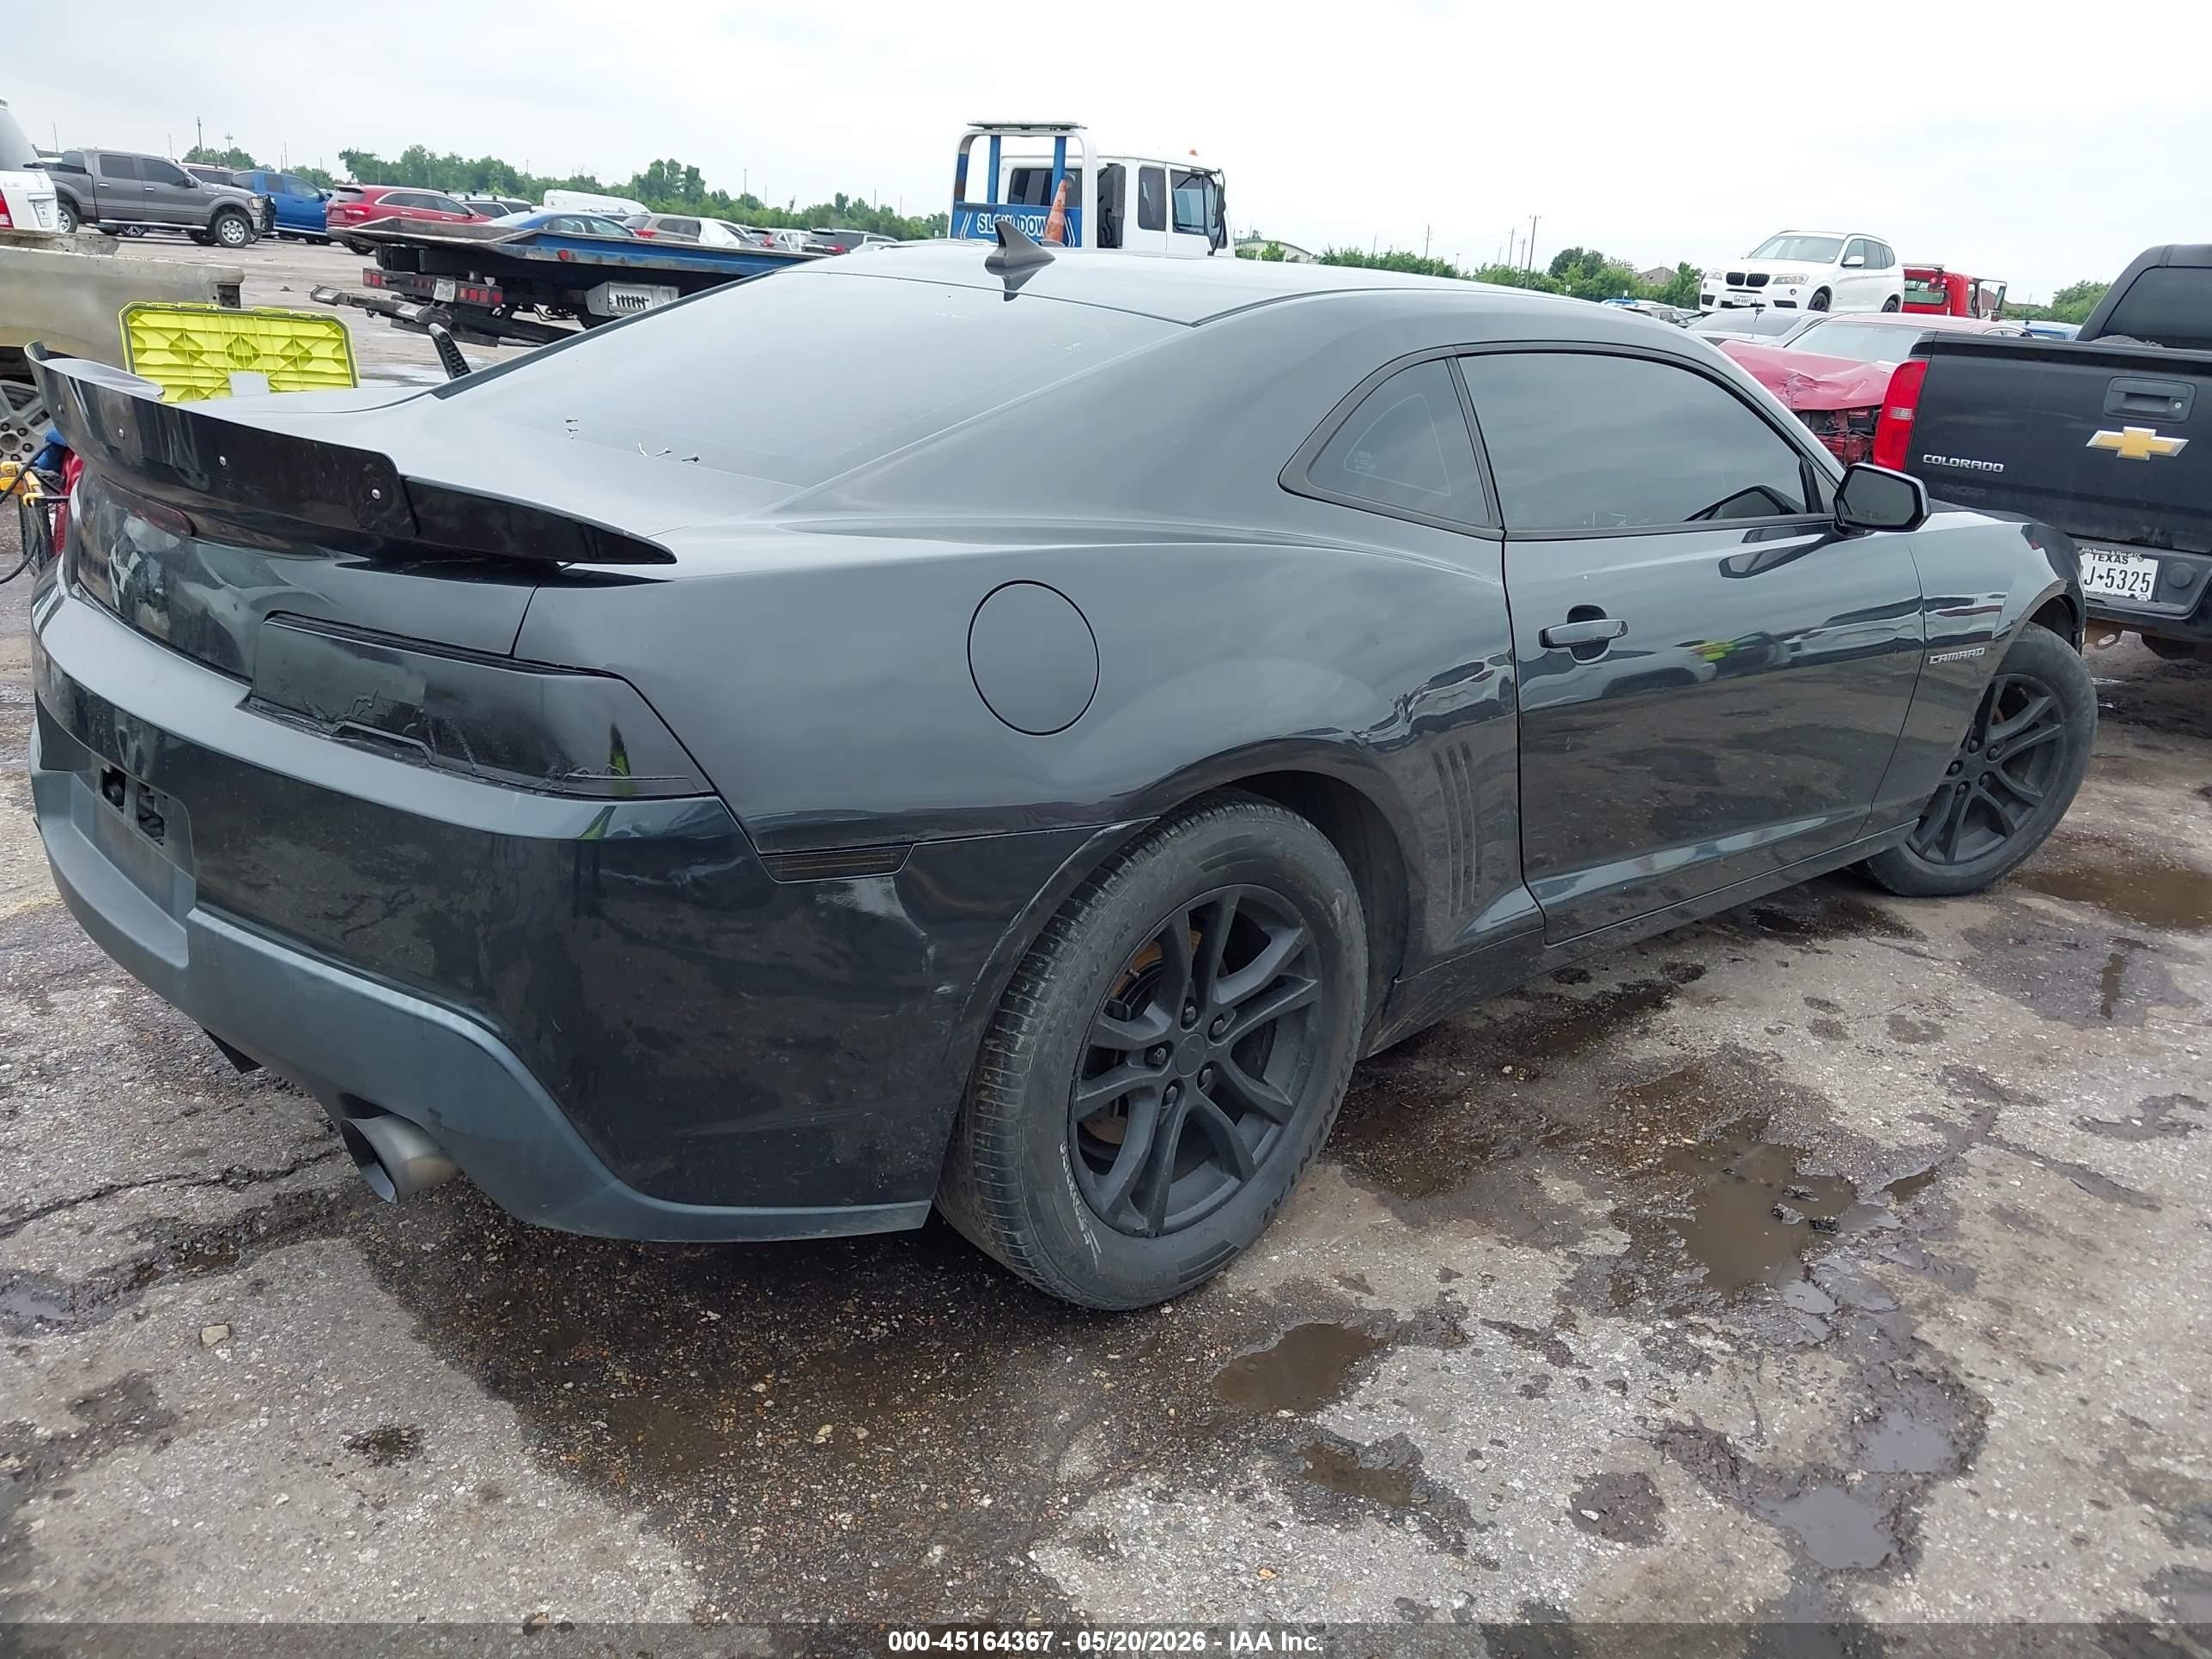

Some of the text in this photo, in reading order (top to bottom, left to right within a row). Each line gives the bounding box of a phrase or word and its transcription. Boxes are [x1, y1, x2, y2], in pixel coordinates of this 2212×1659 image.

[1018, 215, 1047, 237] DOW
[1923, 453, 2004, 473] COLORADO
[2091, 554, 2130, 565] TEXAS
[1929, 647, 1985, 665] CAMARO
